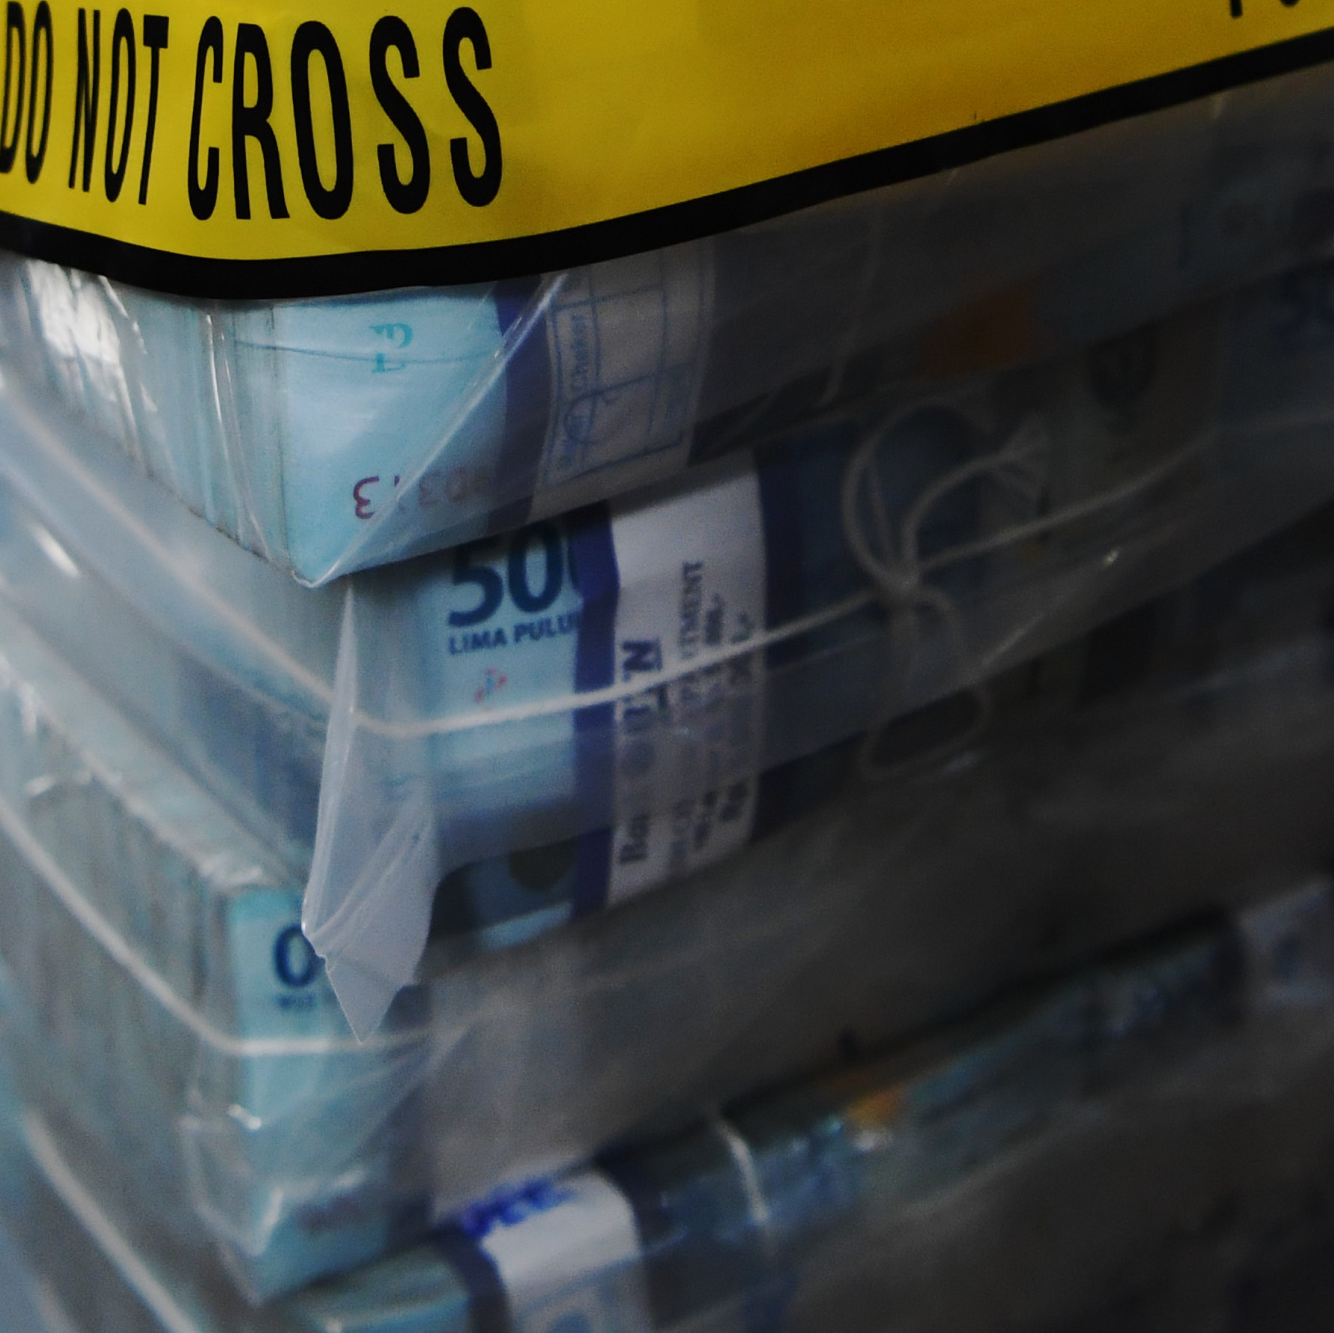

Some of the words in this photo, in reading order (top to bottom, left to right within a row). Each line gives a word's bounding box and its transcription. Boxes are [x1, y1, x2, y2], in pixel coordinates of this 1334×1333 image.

[68, 7, 169, 207] NOT
[187, 7, 504, 221] CROSS
[447, 522, 583, 627] 50
[448, 627, 508, 656] LIMA
